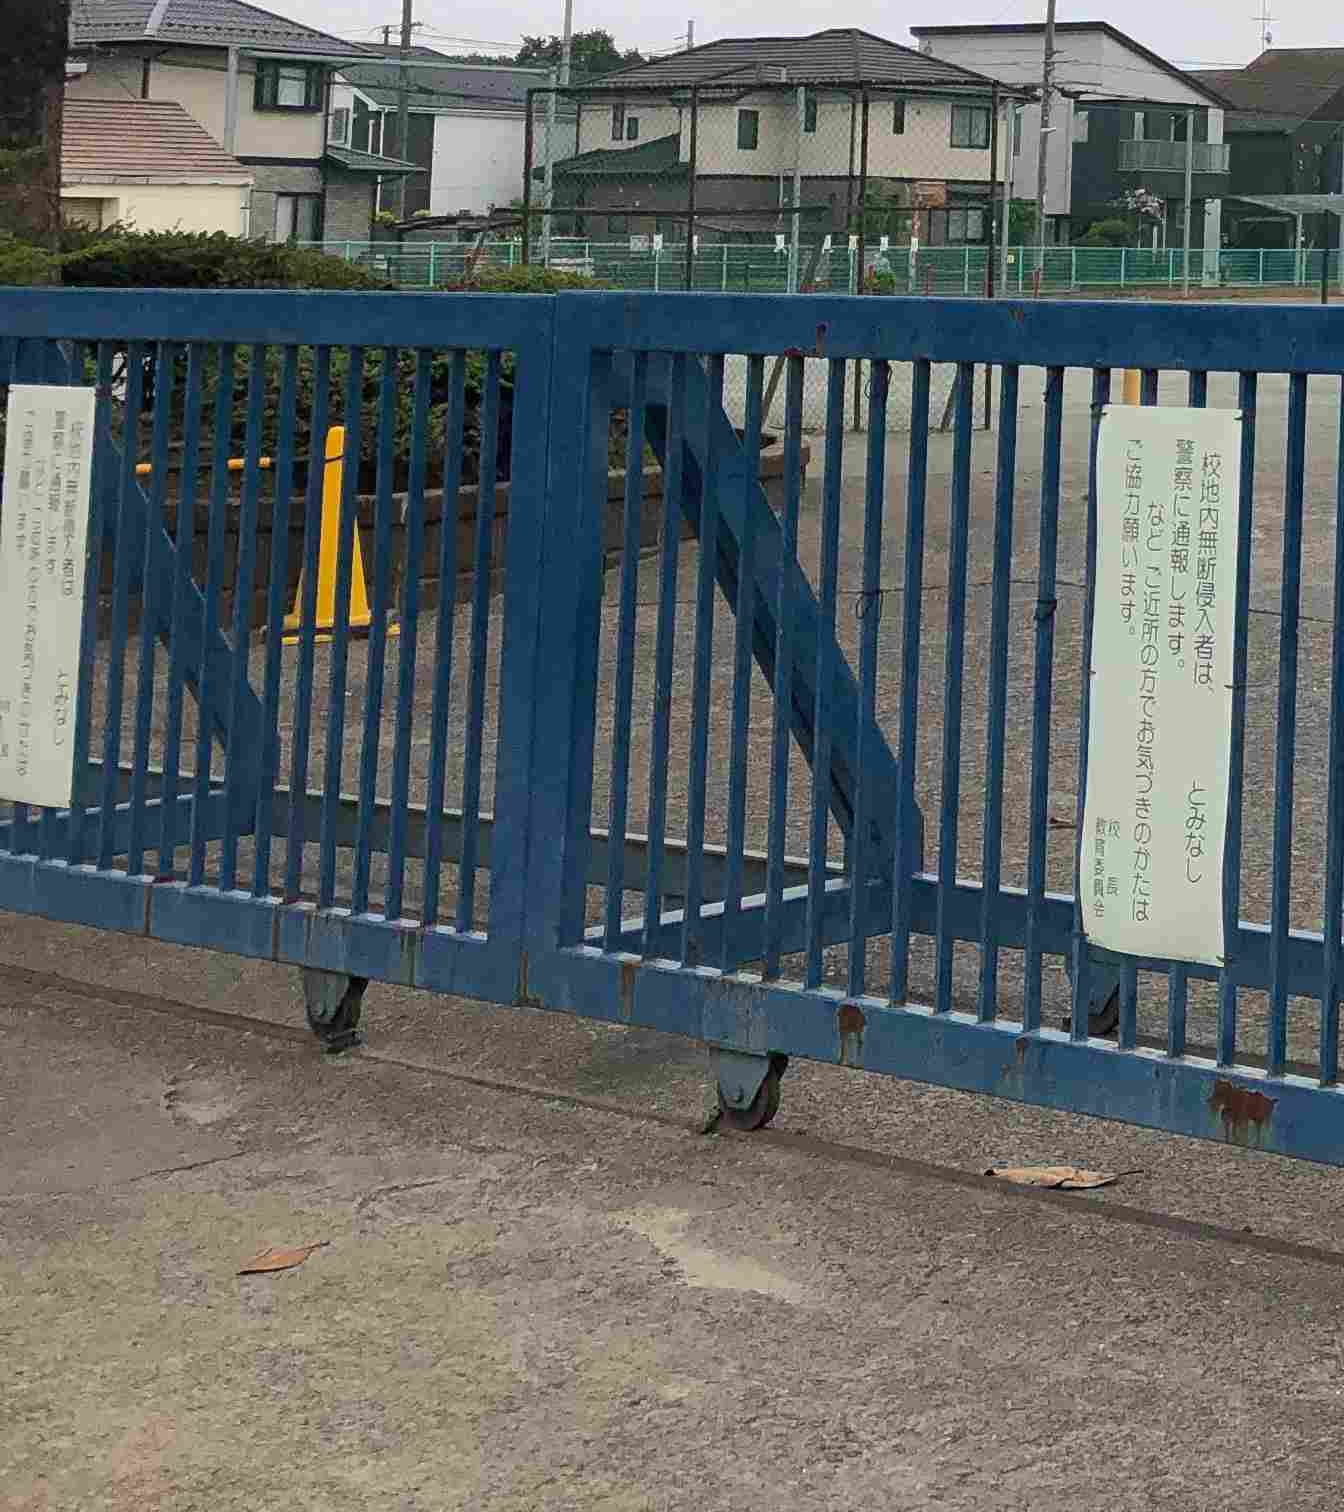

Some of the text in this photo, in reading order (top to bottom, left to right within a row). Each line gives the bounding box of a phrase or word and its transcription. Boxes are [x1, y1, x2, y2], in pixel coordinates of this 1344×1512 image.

[1120, 439, 1144, 636] ご協力願います。
[1168, 439, 1195, 670] 警察に通報します。
